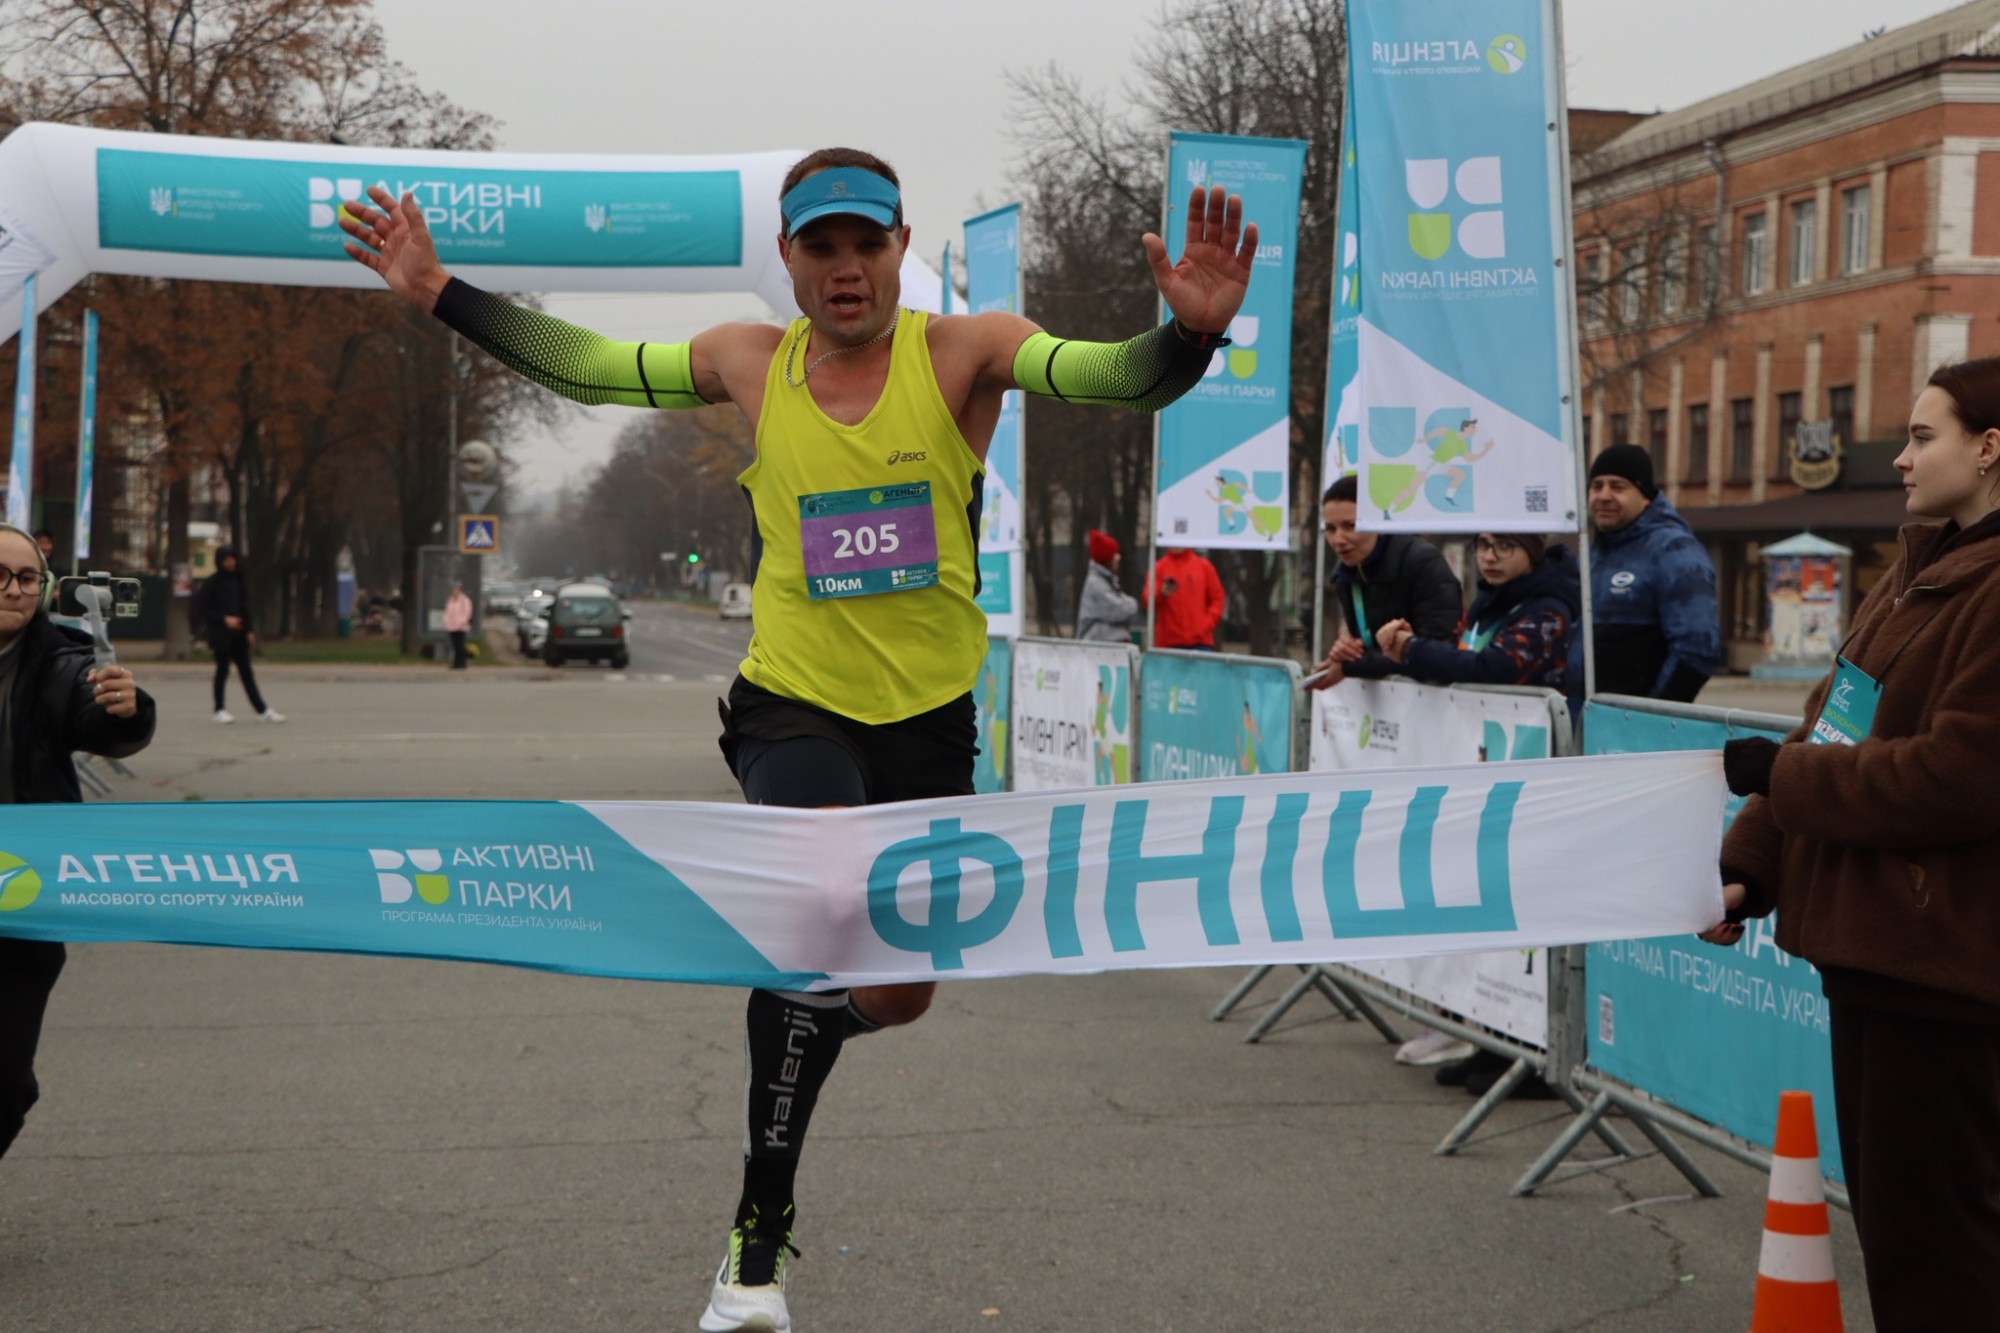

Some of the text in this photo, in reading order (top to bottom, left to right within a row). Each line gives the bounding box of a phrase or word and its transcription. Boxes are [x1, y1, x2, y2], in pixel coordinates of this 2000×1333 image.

[1194, 383, 1276, 398] ТИВНІ ПАРКИ
[901, 451, 926, 462] asics
[832, 523, 900, 559] 205
[57, 853, 299, 889] АГЕНЦІЯ
[452, 844, 595, 872] АКТИВНІ
[867, 781, 1526, 971] ФІНІШ
[60, 891, 304, 908] МАСОВОГО СПОРТУ УКРАЇНИ
[458, 880, 571, 912] ПАРКИ
[381, 910, 602, 932] ПРОГРАМА ПРЕЗИДЕНТА УКРАЇНИ
[1670, 949, 1777, 1016] ПРЕЗИДЕНТА
